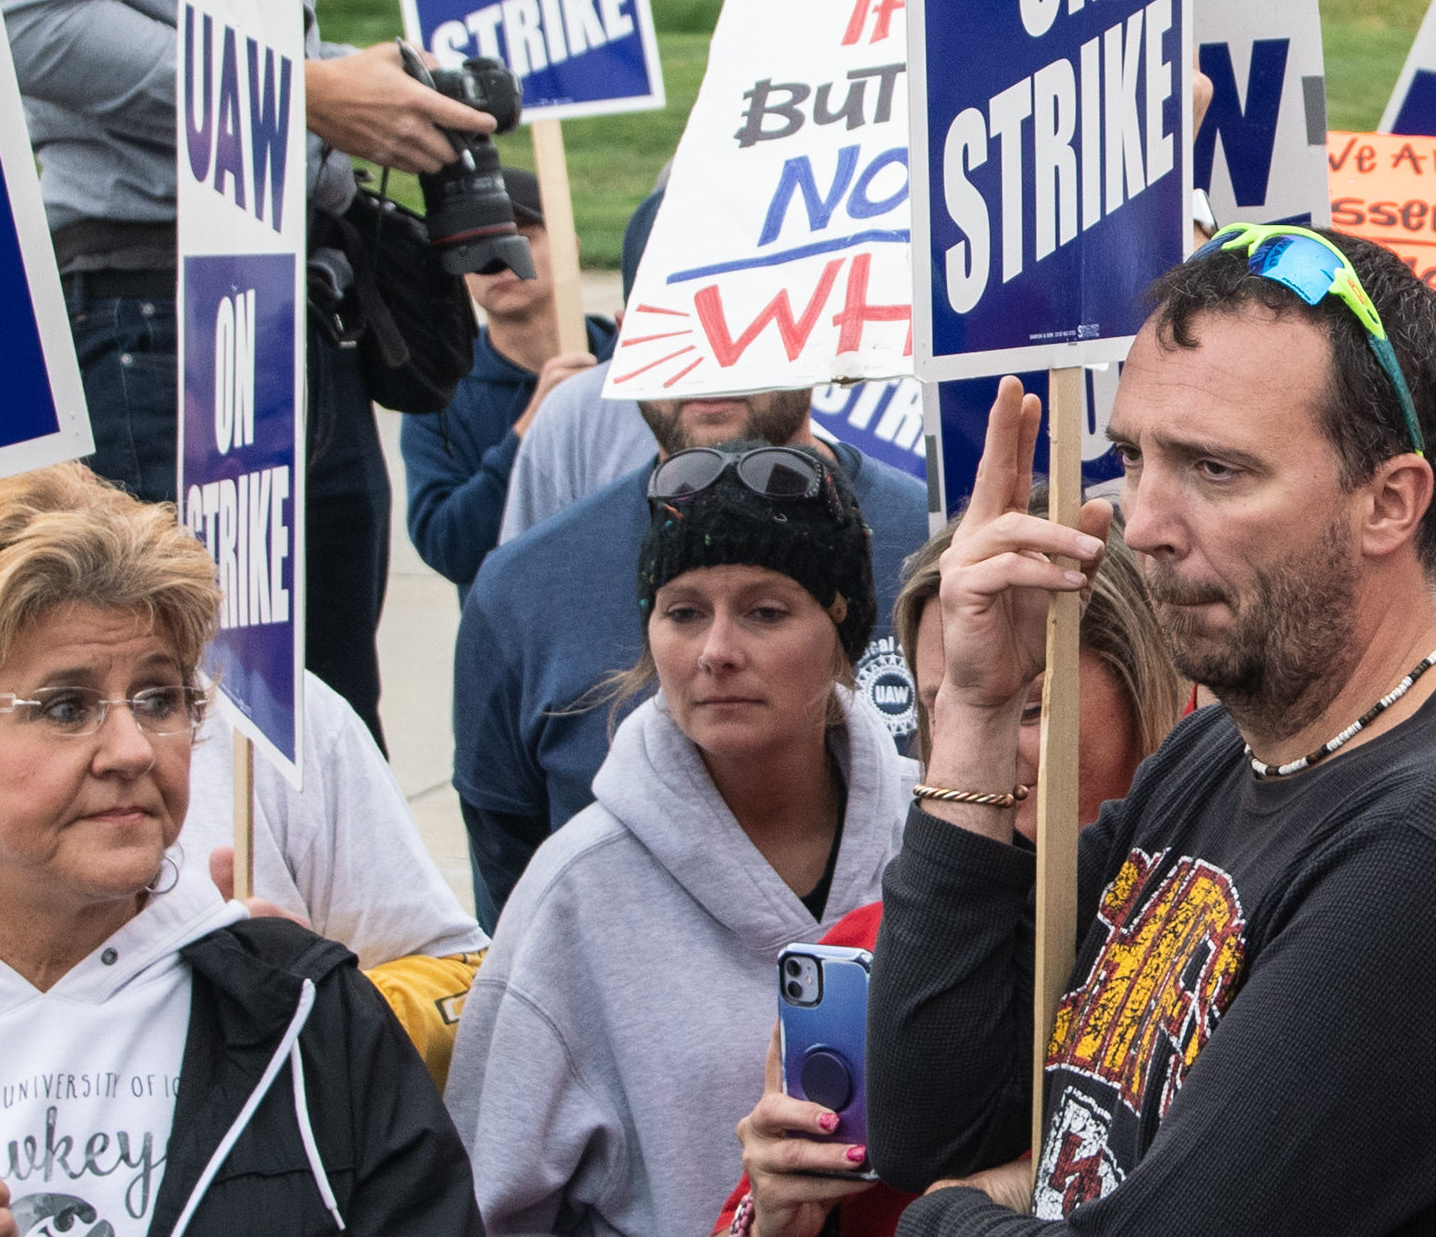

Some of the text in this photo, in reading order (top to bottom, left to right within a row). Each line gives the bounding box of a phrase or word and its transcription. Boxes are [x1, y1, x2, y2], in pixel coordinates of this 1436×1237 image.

[185, 3, 294, 233] UAW
[215, 289, 256, 455] ON
[875, 685, 910, 703] UAW
[4, 1072, 120, 1109] UNIVERSITY
[131, 1074, 162, 1098] OF
[164, 1074, 180, 1098] IO
